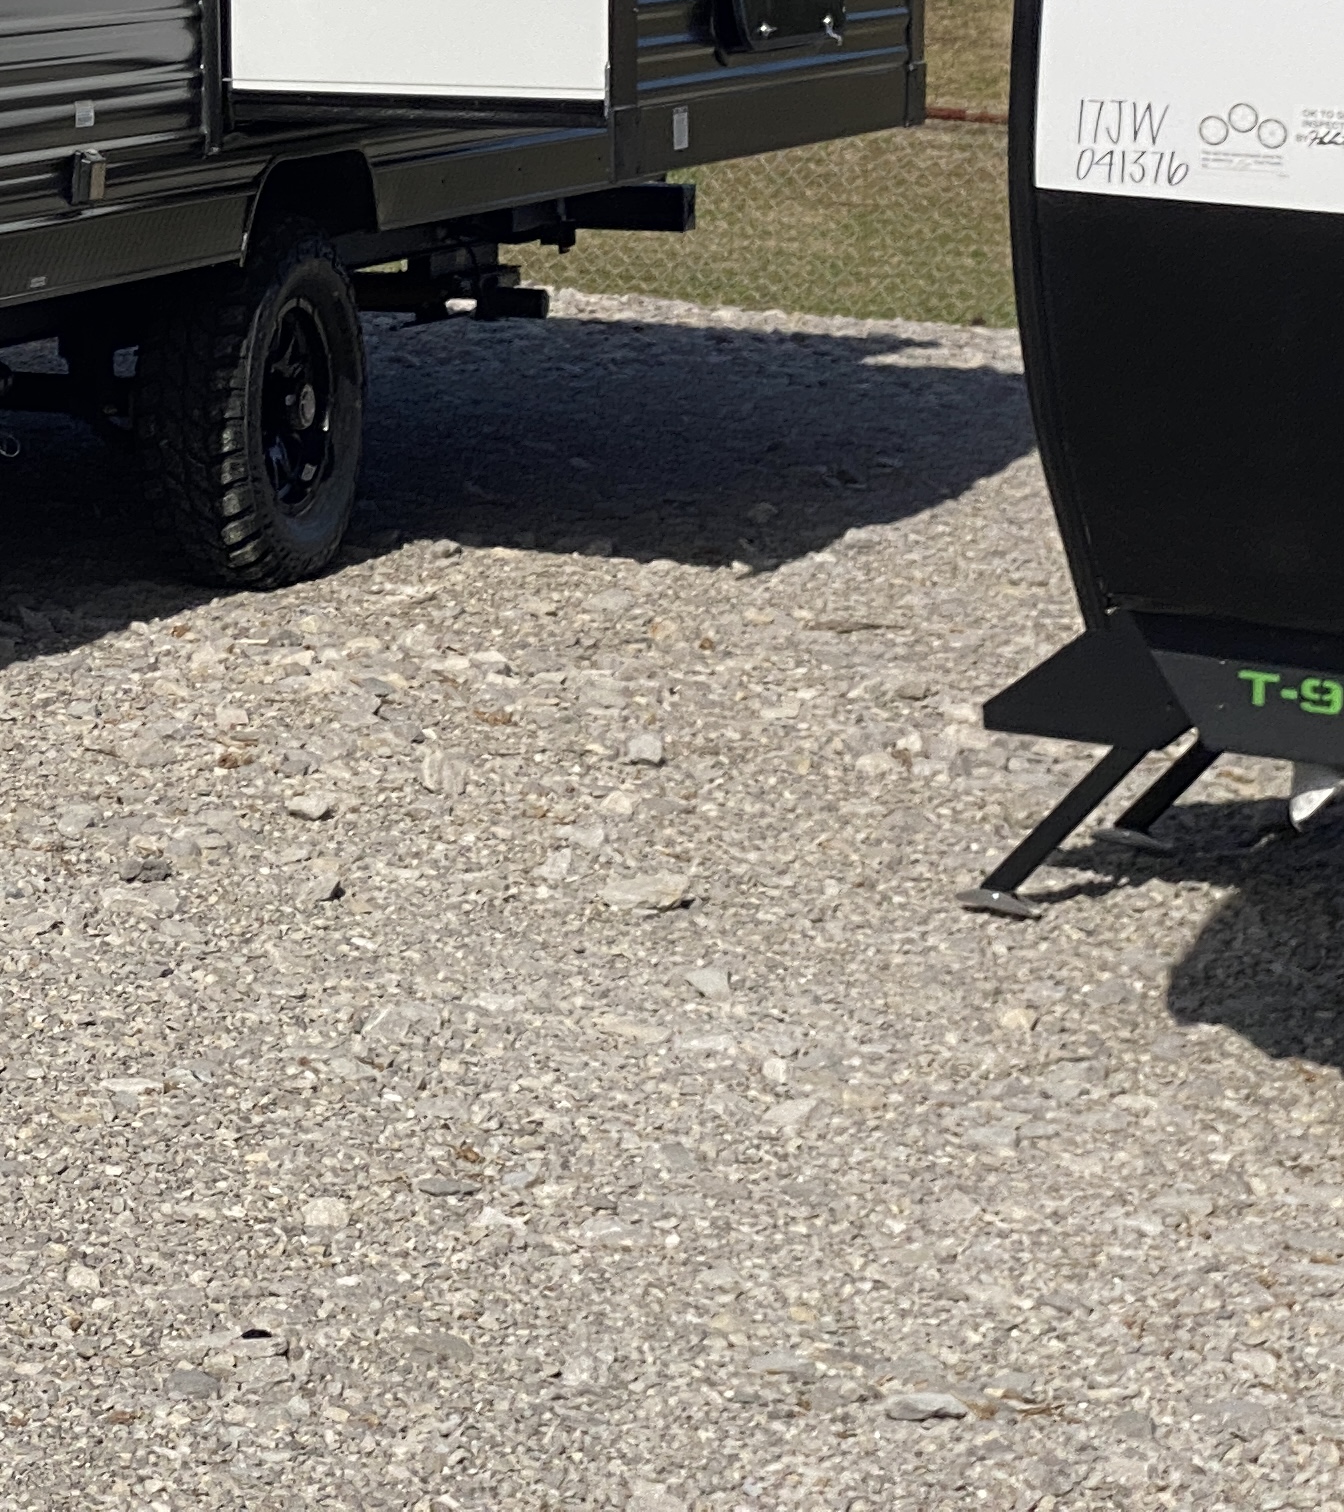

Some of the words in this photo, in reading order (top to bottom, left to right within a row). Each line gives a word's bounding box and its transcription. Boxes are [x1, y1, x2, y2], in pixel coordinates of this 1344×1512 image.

[1077, 98, 1170, 146] 17JW
[1076, 148, 1190, 187] 041376
[1237, 668, 1344, 716] T-9
